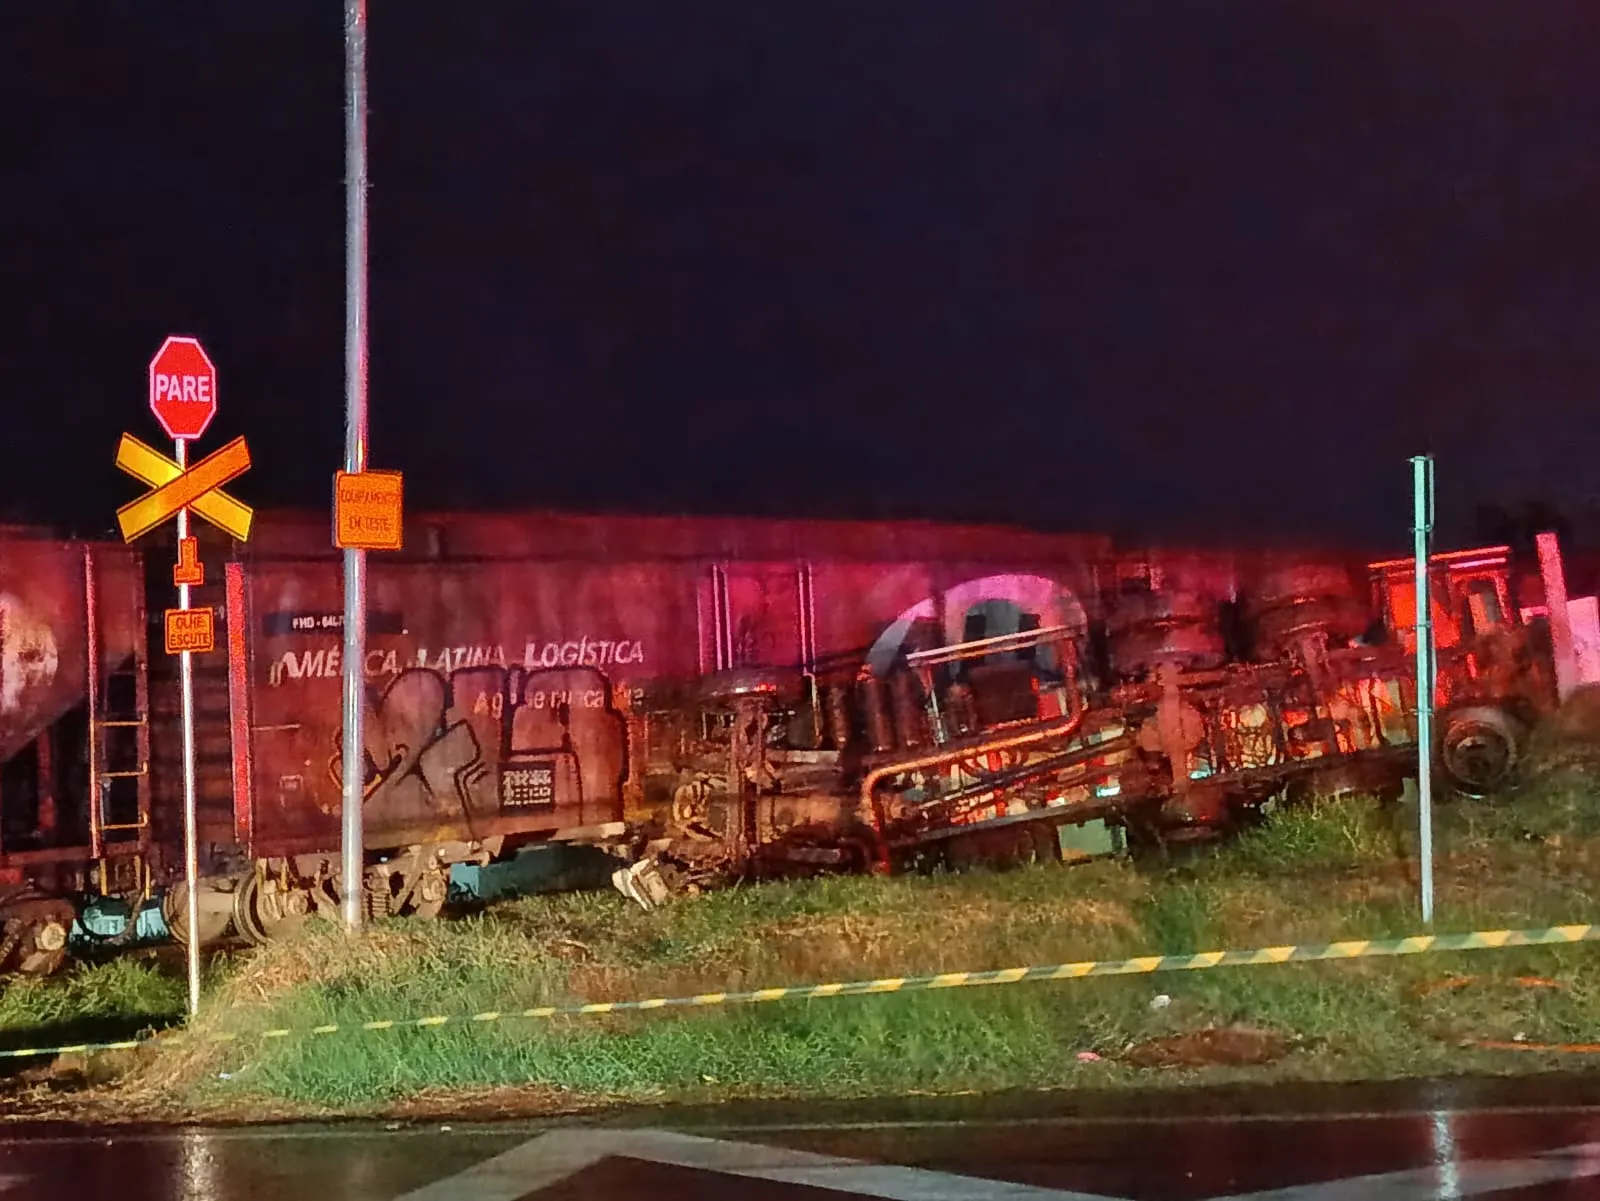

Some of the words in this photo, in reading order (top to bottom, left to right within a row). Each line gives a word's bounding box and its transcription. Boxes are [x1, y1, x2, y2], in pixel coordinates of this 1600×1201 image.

[155, 374, 211, 403] PARE
[170, 632, 211, 646] ESCUTE
[270, 643, 402, 687] AMÉCA
[523, 635, 644, 668] LOGÍSTICA
